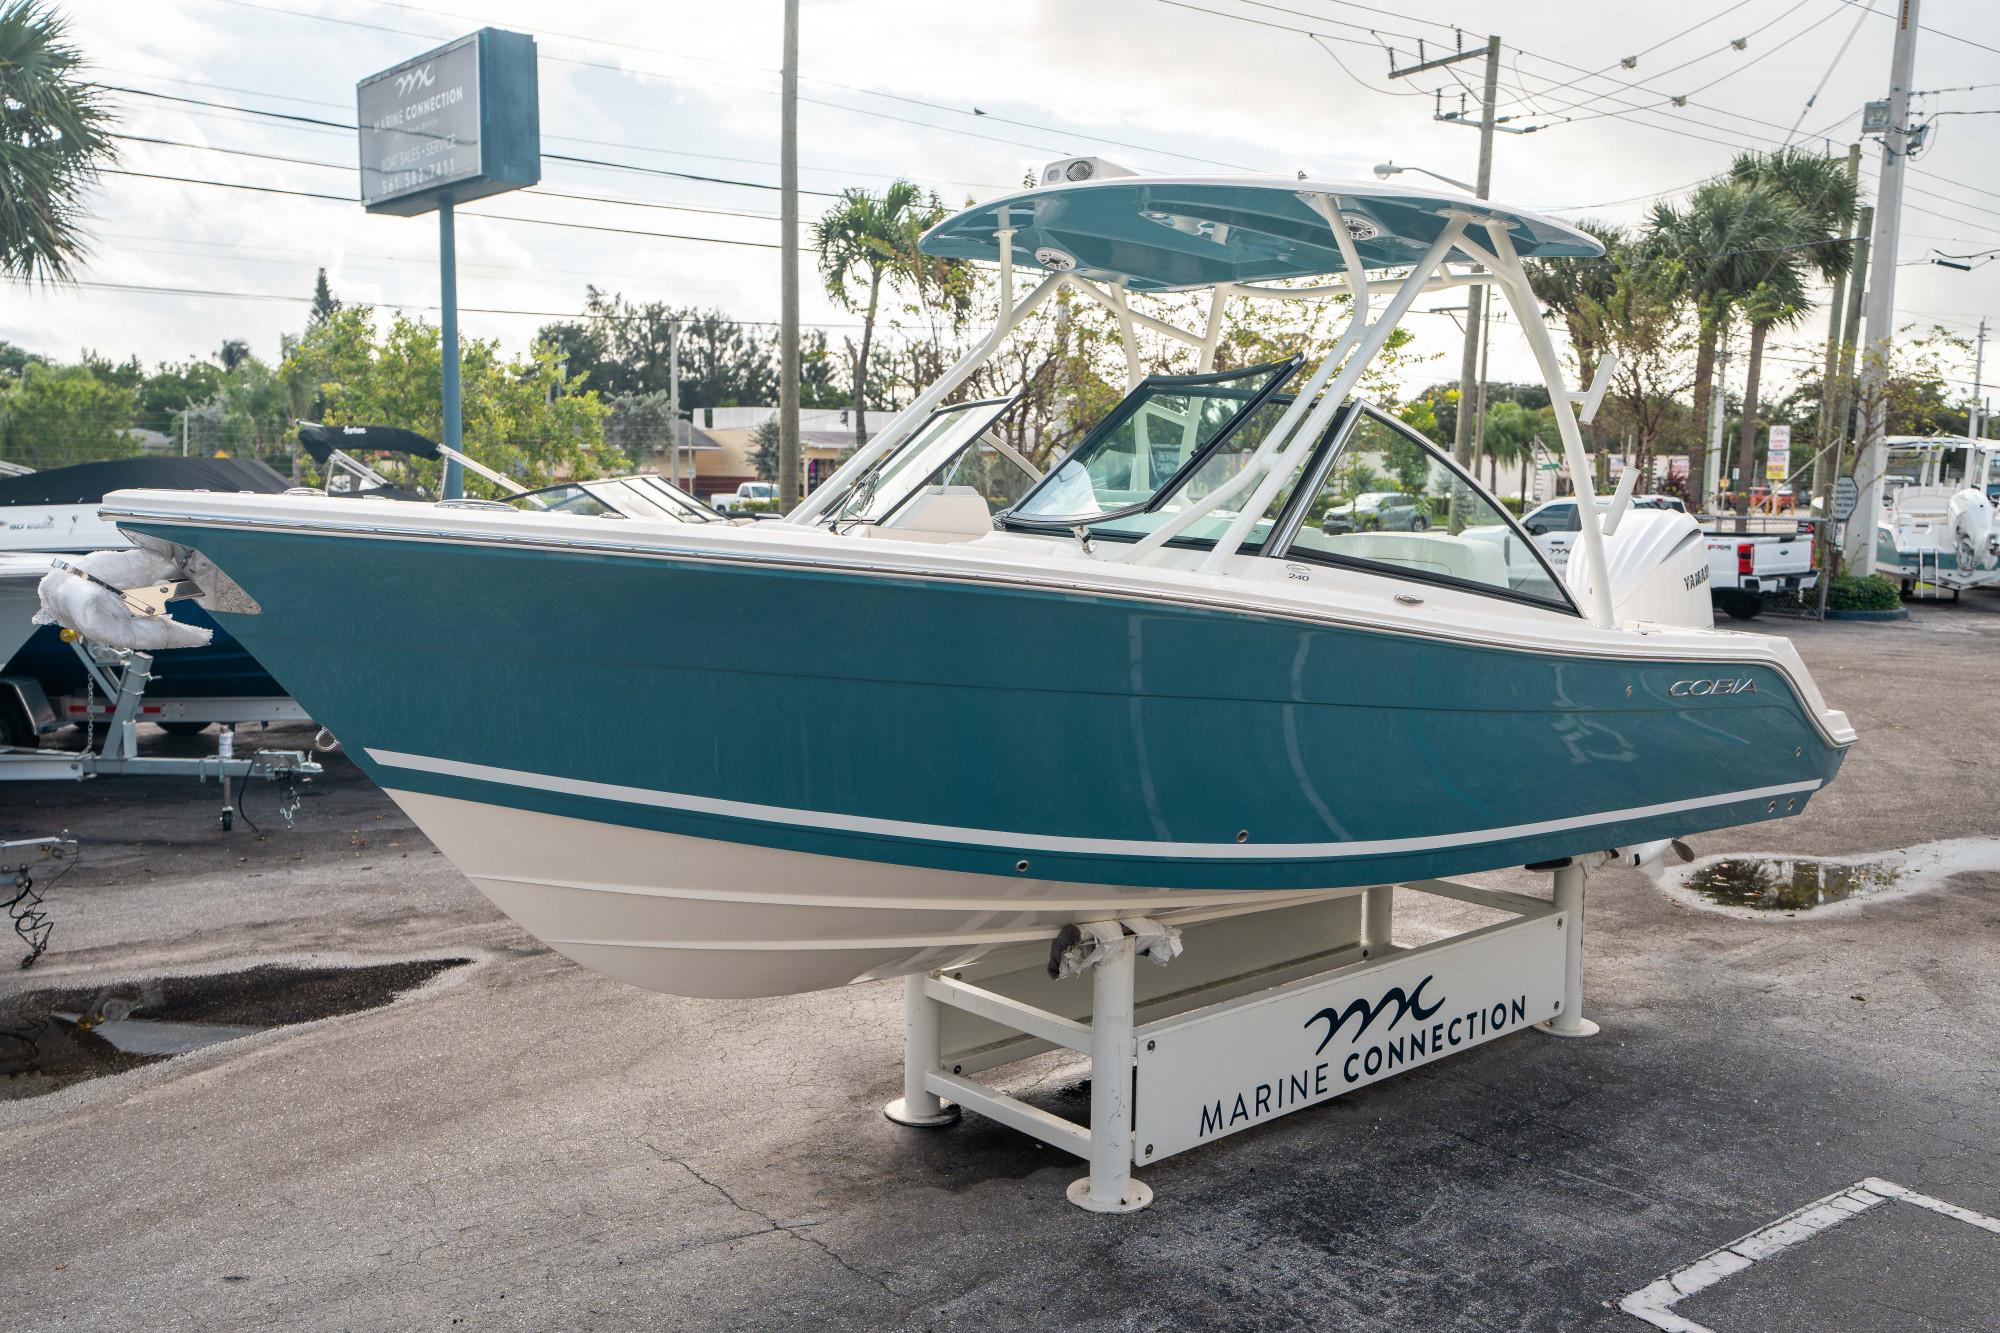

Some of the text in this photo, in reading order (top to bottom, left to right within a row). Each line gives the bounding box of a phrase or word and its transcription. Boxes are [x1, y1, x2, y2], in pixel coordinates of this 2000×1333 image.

[374, 109, 403, 134] MARINE
[405, 86, 463, 120] CONNECTION
[1288, 572, 1310, 582] 240
[1669, 678, 1758, 697] COBIA
[1199, 995, 1527, 1138] MARINE CONNECTION
